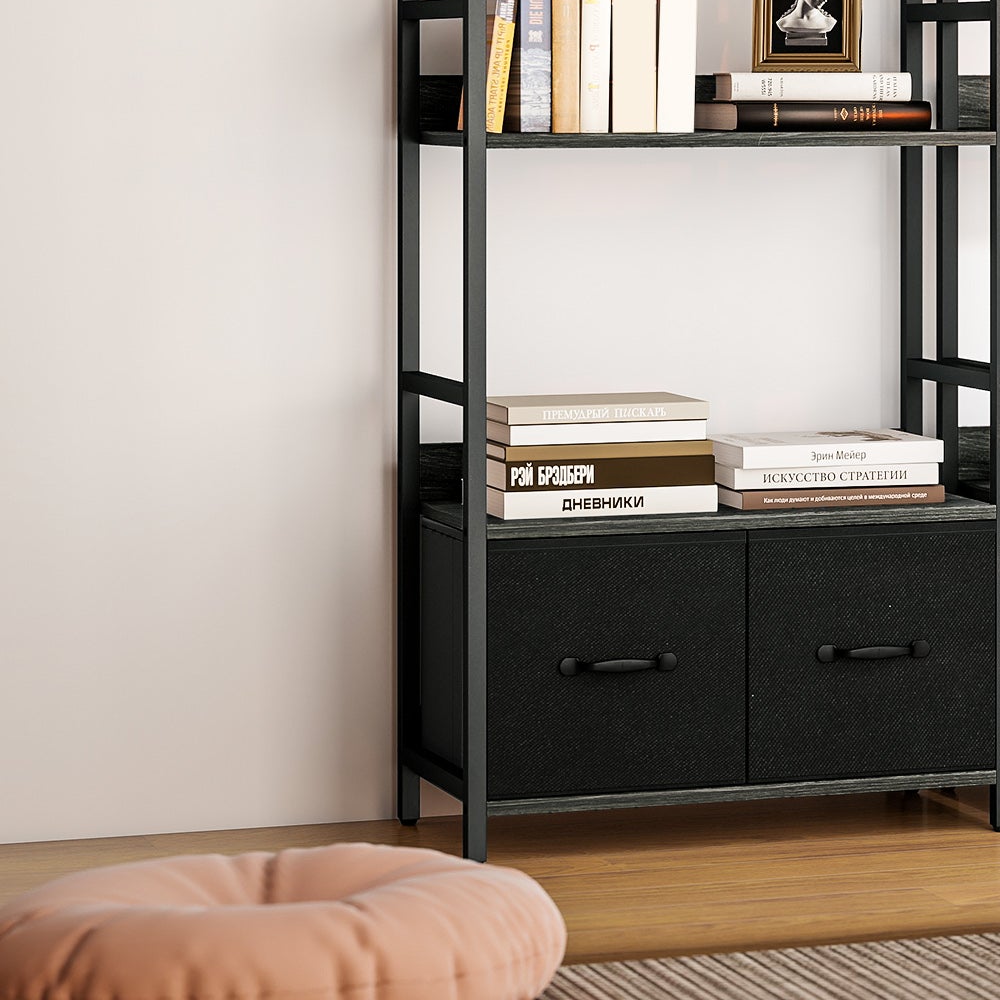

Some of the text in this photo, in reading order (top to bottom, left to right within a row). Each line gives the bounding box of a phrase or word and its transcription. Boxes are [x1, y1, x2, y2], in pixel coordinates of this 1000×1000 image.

[543, 406, 667, 420] ПРЕМУДРЫЙ ПИСКАРЬ
[811, 450, 867, 462] Эрин Мейер
[510, 462, 595, 487] РЭЙ БРЭДБЕРИ
[763, 470, 908, 484] ИСКУССТВО СТРАТЕГИИ
[562, 496, 645, 512] ДНЕВНИКИ
[789, 496, 810, 504] думают
[847, 493, 863, 501] целей
[868, 492, 911, 500] международной
